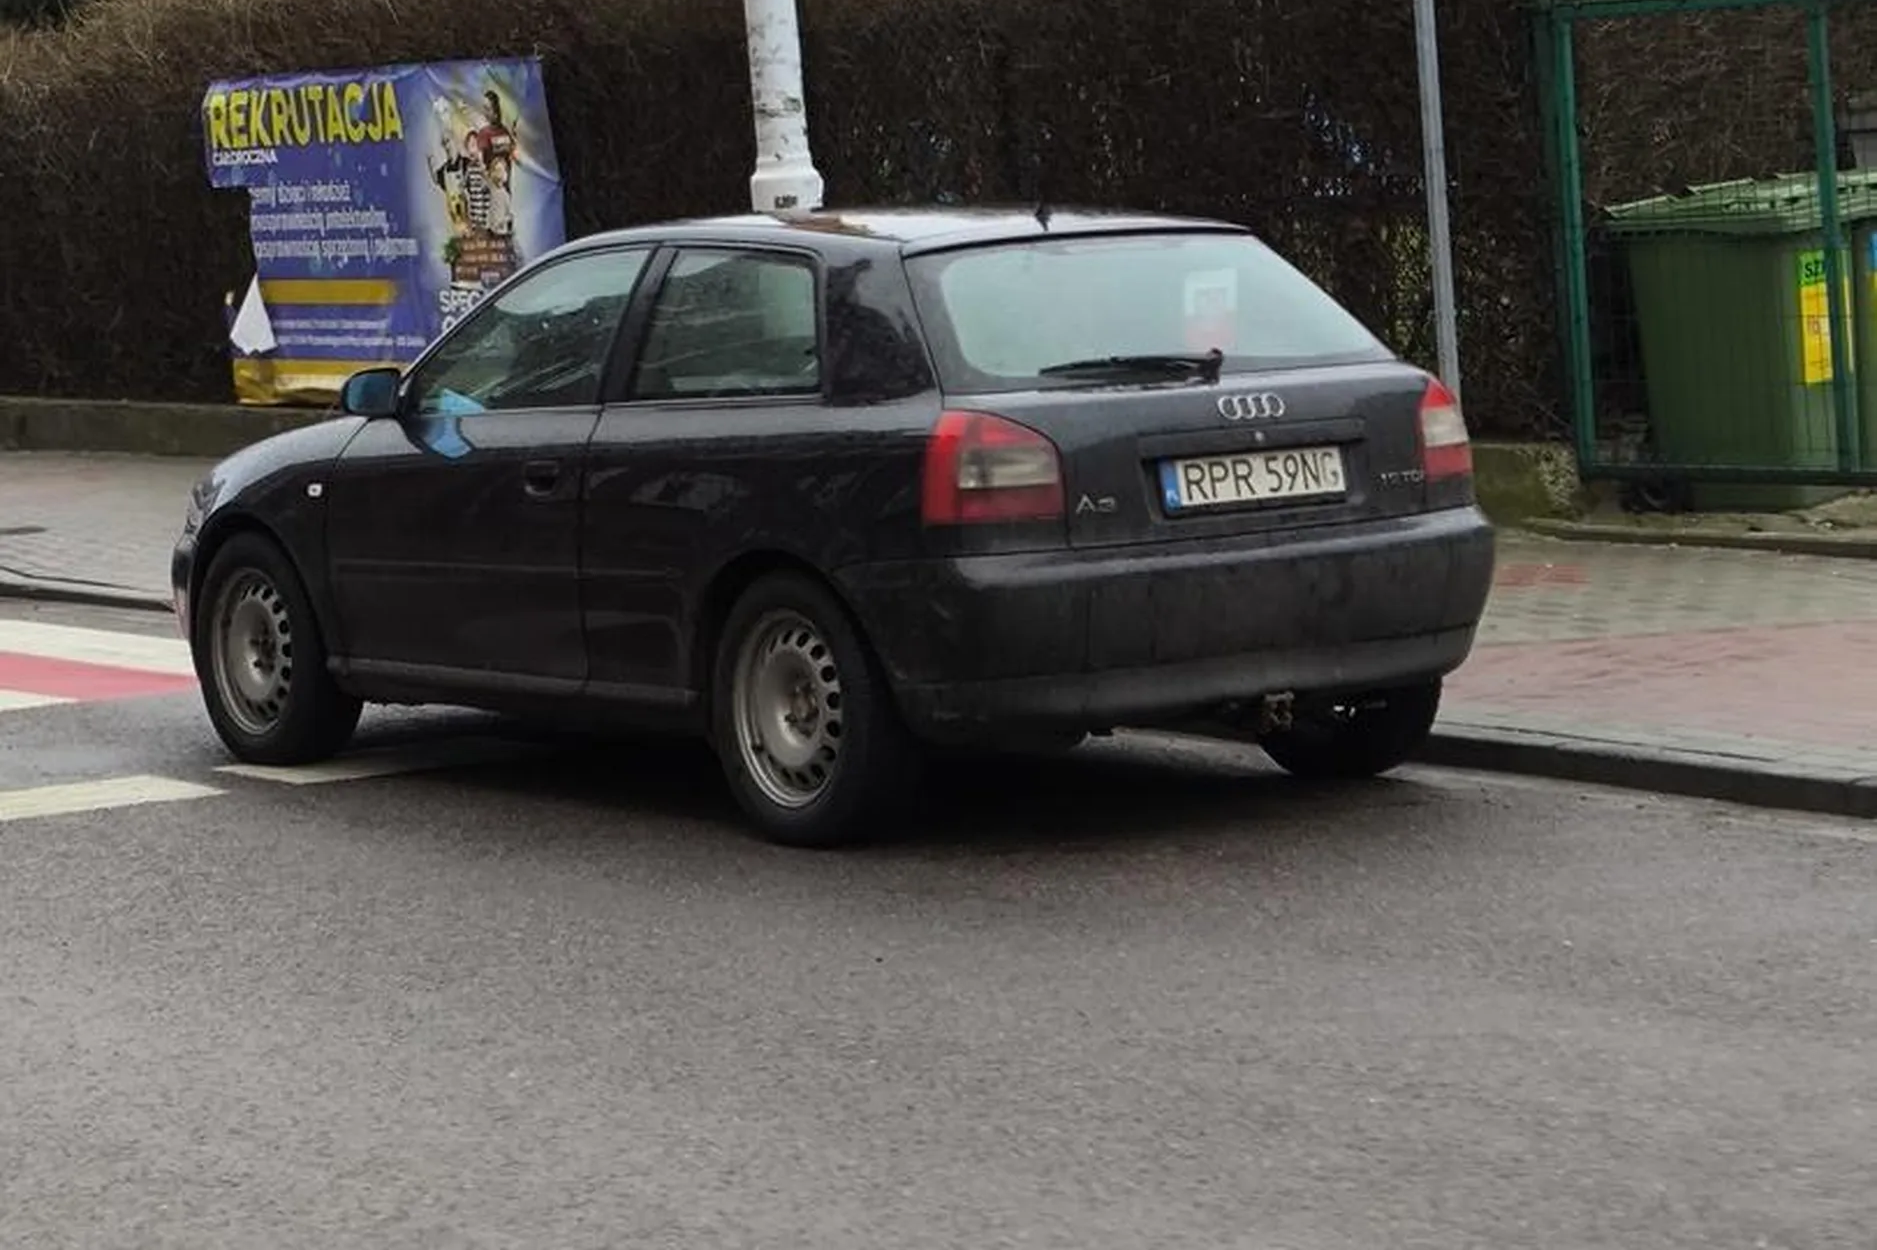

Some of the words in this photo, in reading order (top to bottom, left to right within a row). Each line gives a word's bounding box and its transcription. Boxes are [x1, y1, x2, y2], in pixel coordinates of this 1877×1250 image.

[209, 82, 404, 149] REKRUTACJA
[1183, 458, 1257, 500] RPR
[1265, 452, 1338, 492] 59NG
